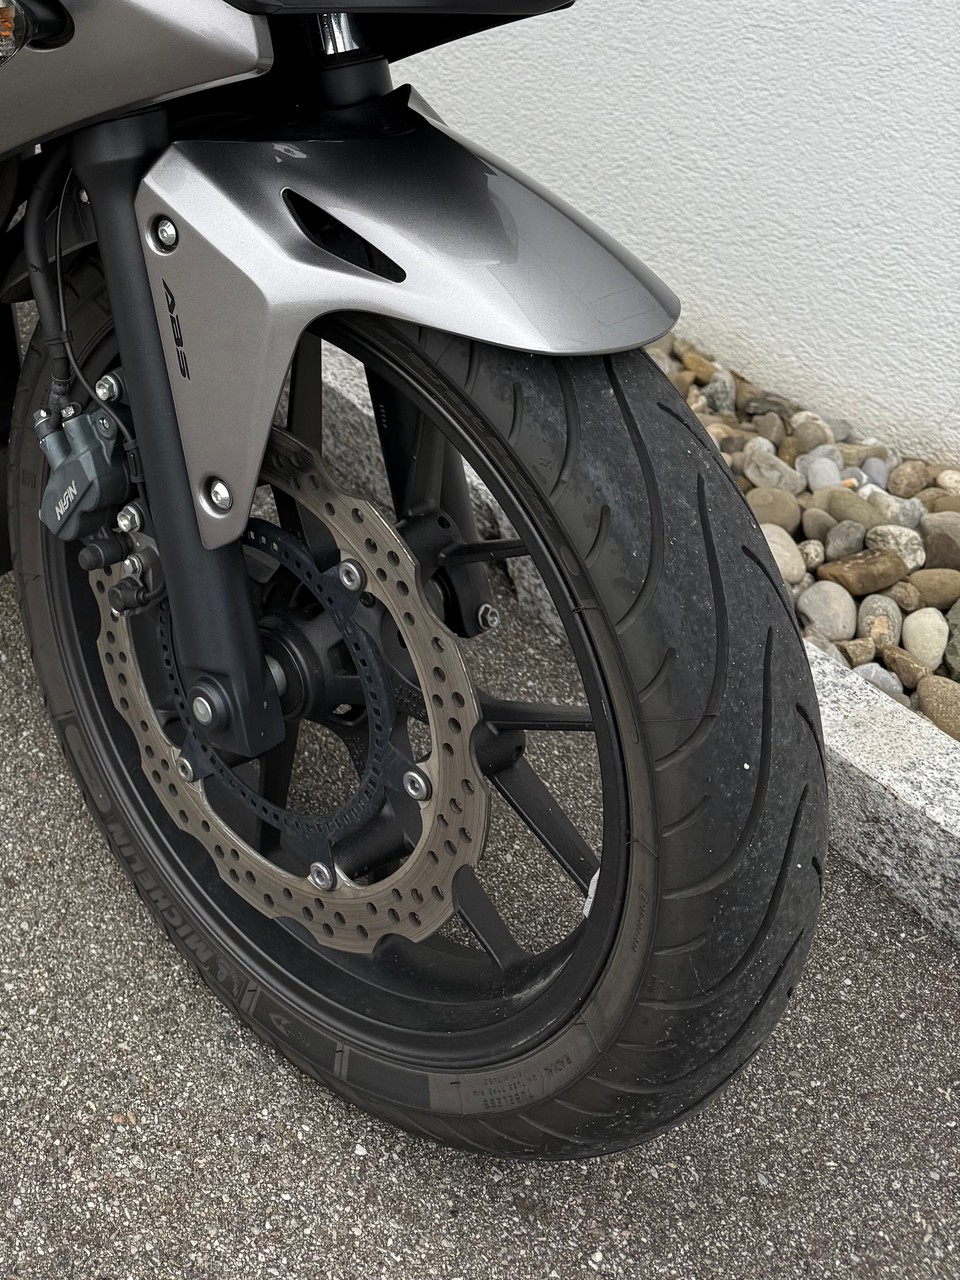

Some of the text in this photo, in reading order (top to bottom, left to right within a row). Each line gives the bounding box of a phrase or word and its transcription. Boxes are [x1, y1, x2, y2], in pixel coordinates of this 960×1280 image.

[161, 276, 191, 381] ABS
[54, 479, 78, 522] NISSIN
[106, 821, 218, 964] MICHELIN
[483, 1090, 535, 1109] TUBELESS
